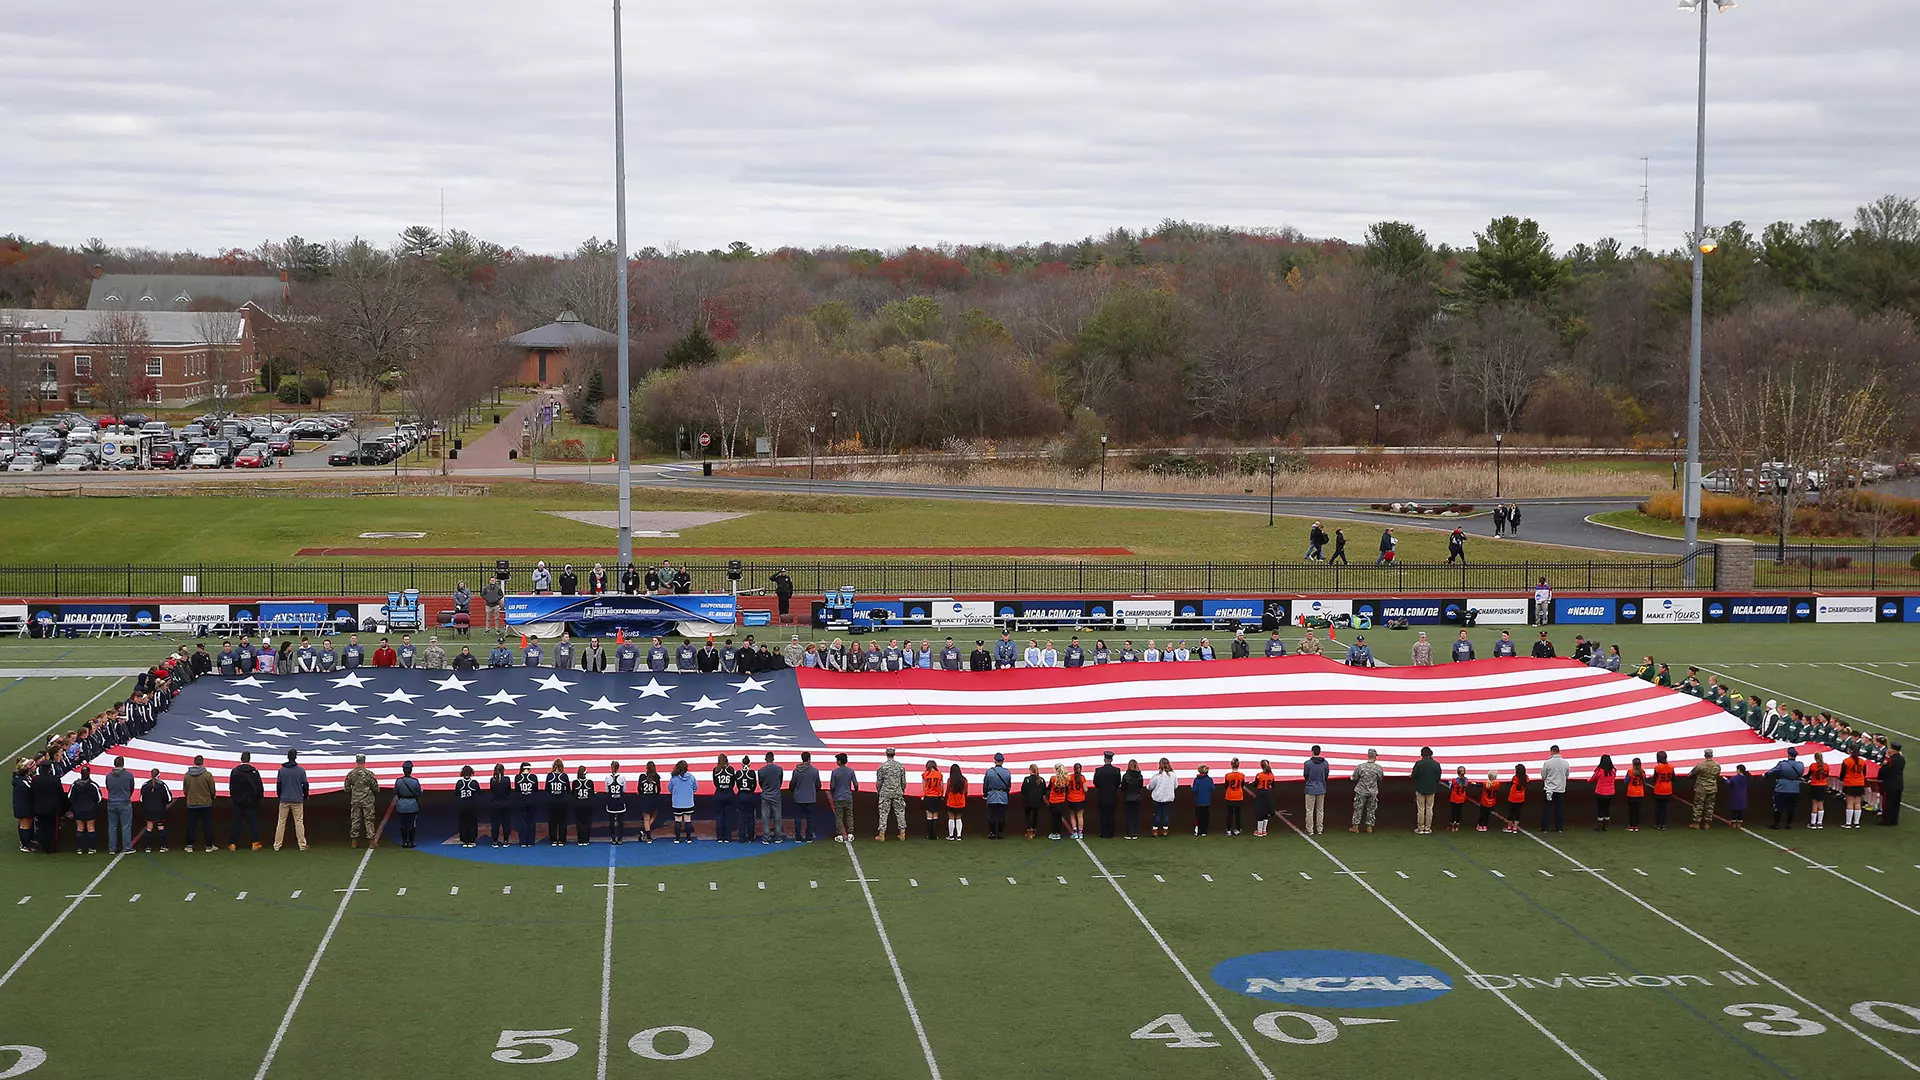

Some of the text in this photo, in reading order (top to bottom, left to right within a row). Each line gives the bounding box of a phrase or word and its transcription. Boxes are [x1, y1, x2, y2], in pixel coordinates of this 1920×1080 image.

[1024, 609, 1082, 618] NCAA.COM/D2
[1124, 609, 1172, 617] CHAMPIONSHIPS
[1215, 608, 1253, 617] #NCAAD2
[1382, 607, 1439, 617] NCAA.COM/D2
[1567, 606, 1605, 616] #NCAAD2
[1673, 608, 1701, 621] YOURS
[1732, 605, 1788, 615] NCAA.COM/D2
[63, 613, 128, 624] NCAA.COM/D2
[717, 774, 731, 784] 126
[742, 778, 748, 788] 5
[519, 782, 533, 792] 102
[550, 782, 563, 791] 118
[610, 784, 621, 794] 82
[643, 782, 654, 792] 28
[577, 788, 589, 798] 45
[1246, 975, 1452, 993] NCAA
[1463, 970, 1760, 990] Division II
